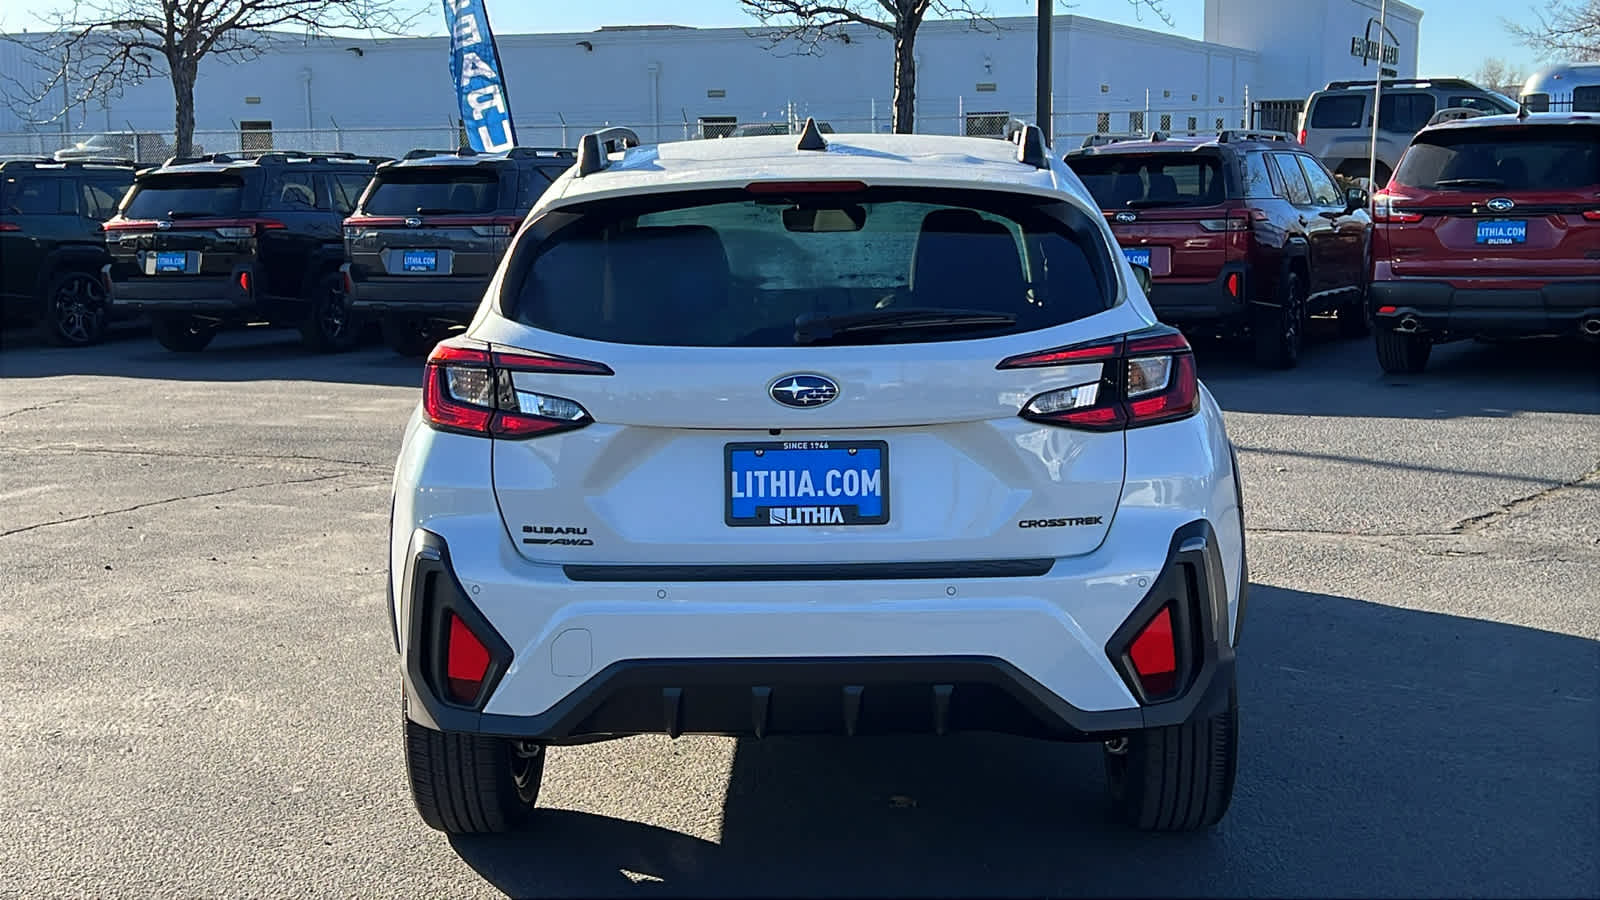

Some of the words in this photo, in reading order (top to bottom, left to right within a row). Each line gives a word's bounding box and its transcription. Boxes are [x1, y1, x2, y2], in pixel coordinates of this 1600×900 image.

[1477, 227, 1526, 237] LITHIA.COM
[783, 442, 808, 450] SINCE
[731, 469, 881, 498] LITHIA.COM
[786, 506, 845, 524] LITHIA
[1018, 515, 1103, 528] CROSSTREK
[522, 525, 588, 535] SUBARU
